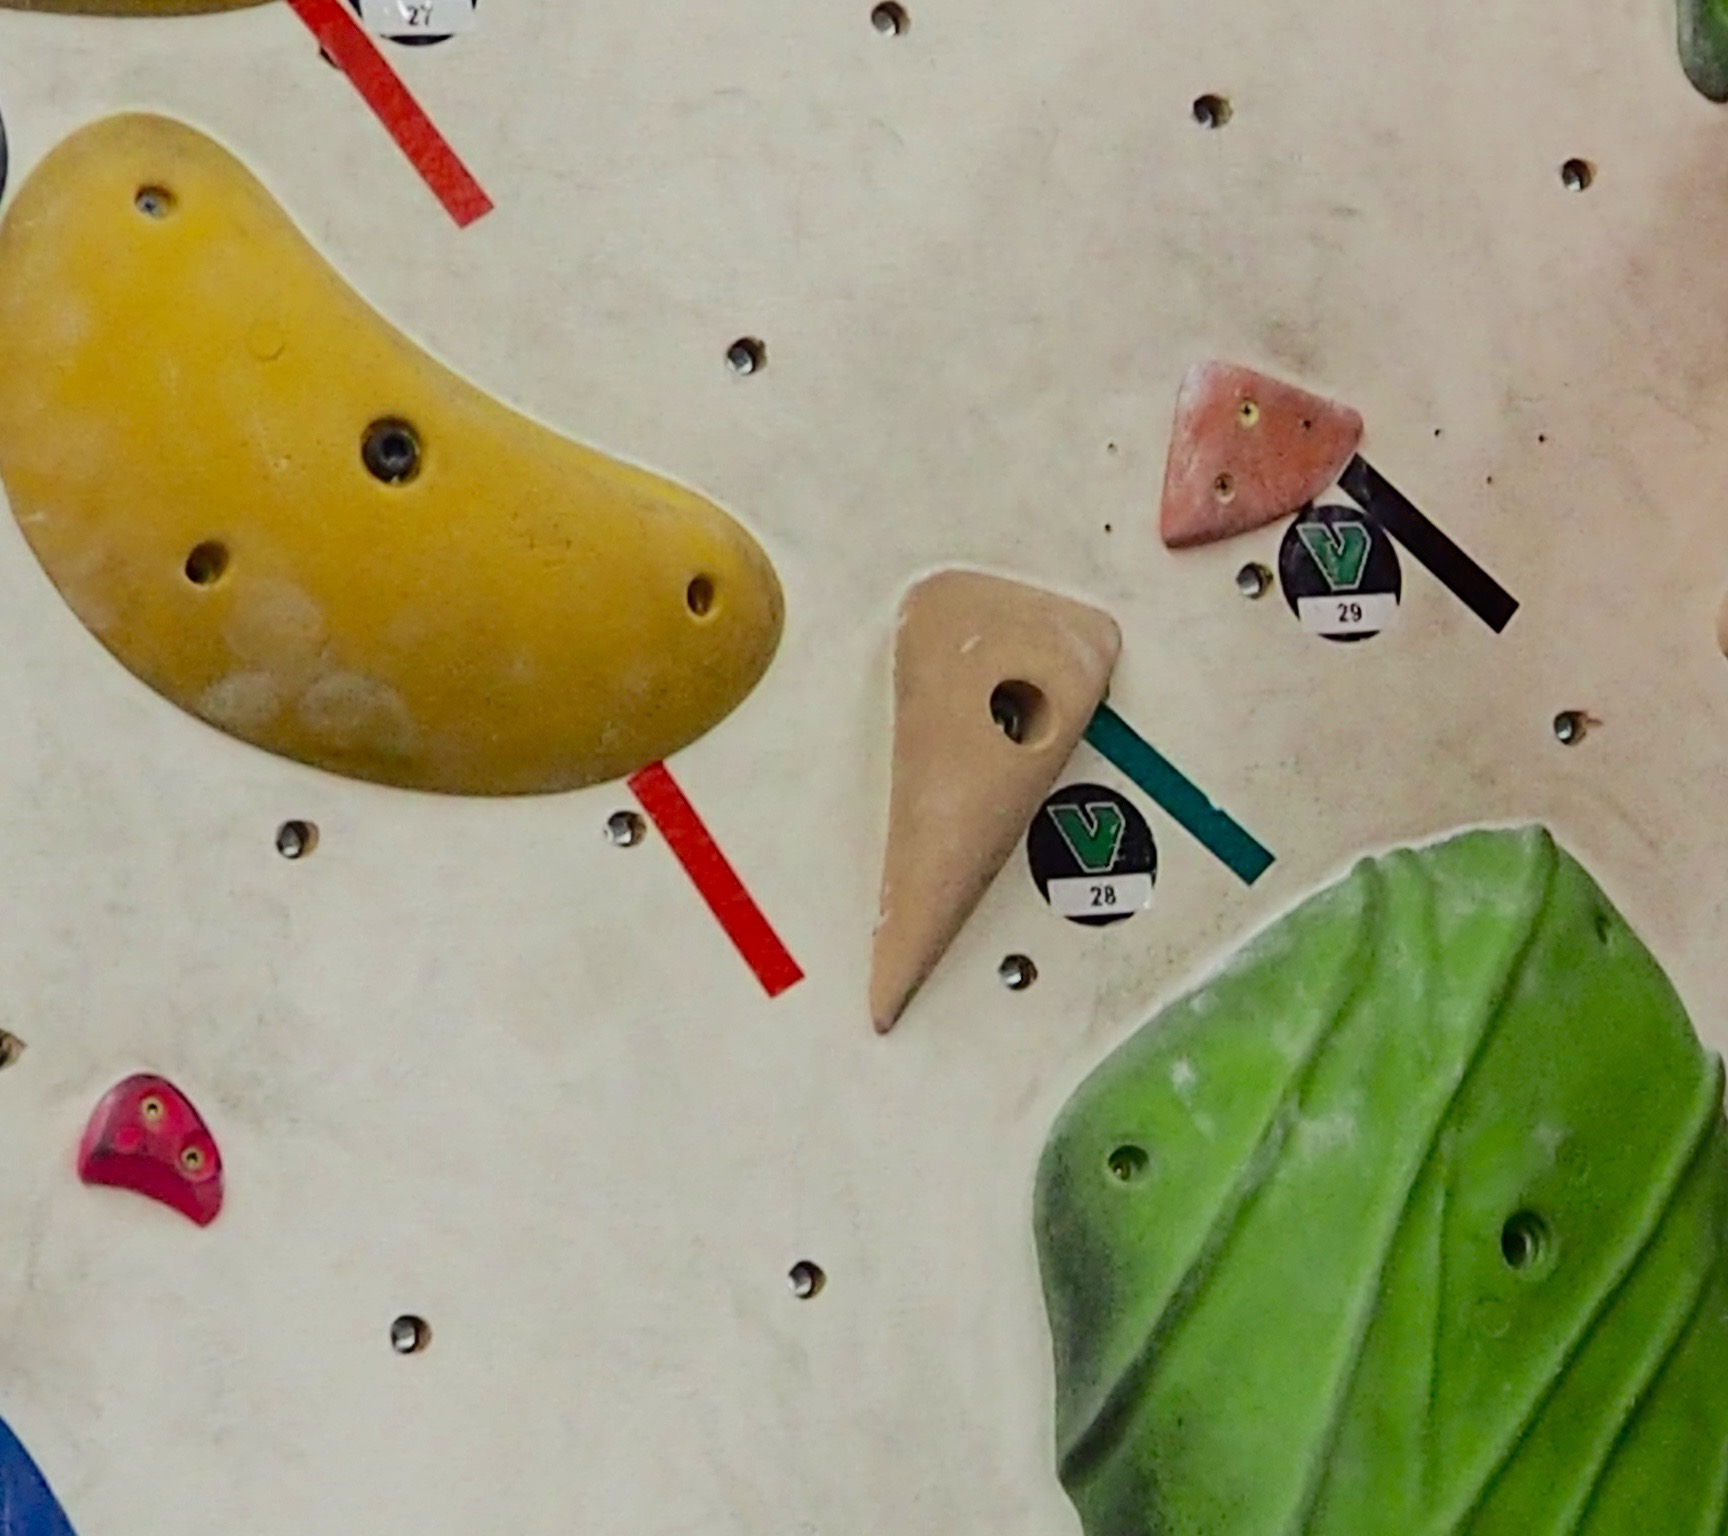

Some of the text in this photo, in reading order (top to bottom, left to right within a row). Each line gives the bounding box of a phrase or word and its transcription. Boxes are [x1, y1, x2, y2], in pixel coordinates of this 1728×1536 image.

[406, 5, 434, 27] 27
[1336, 602, 1363, 623] 29
[1089, 885, 1117, 907] 28
